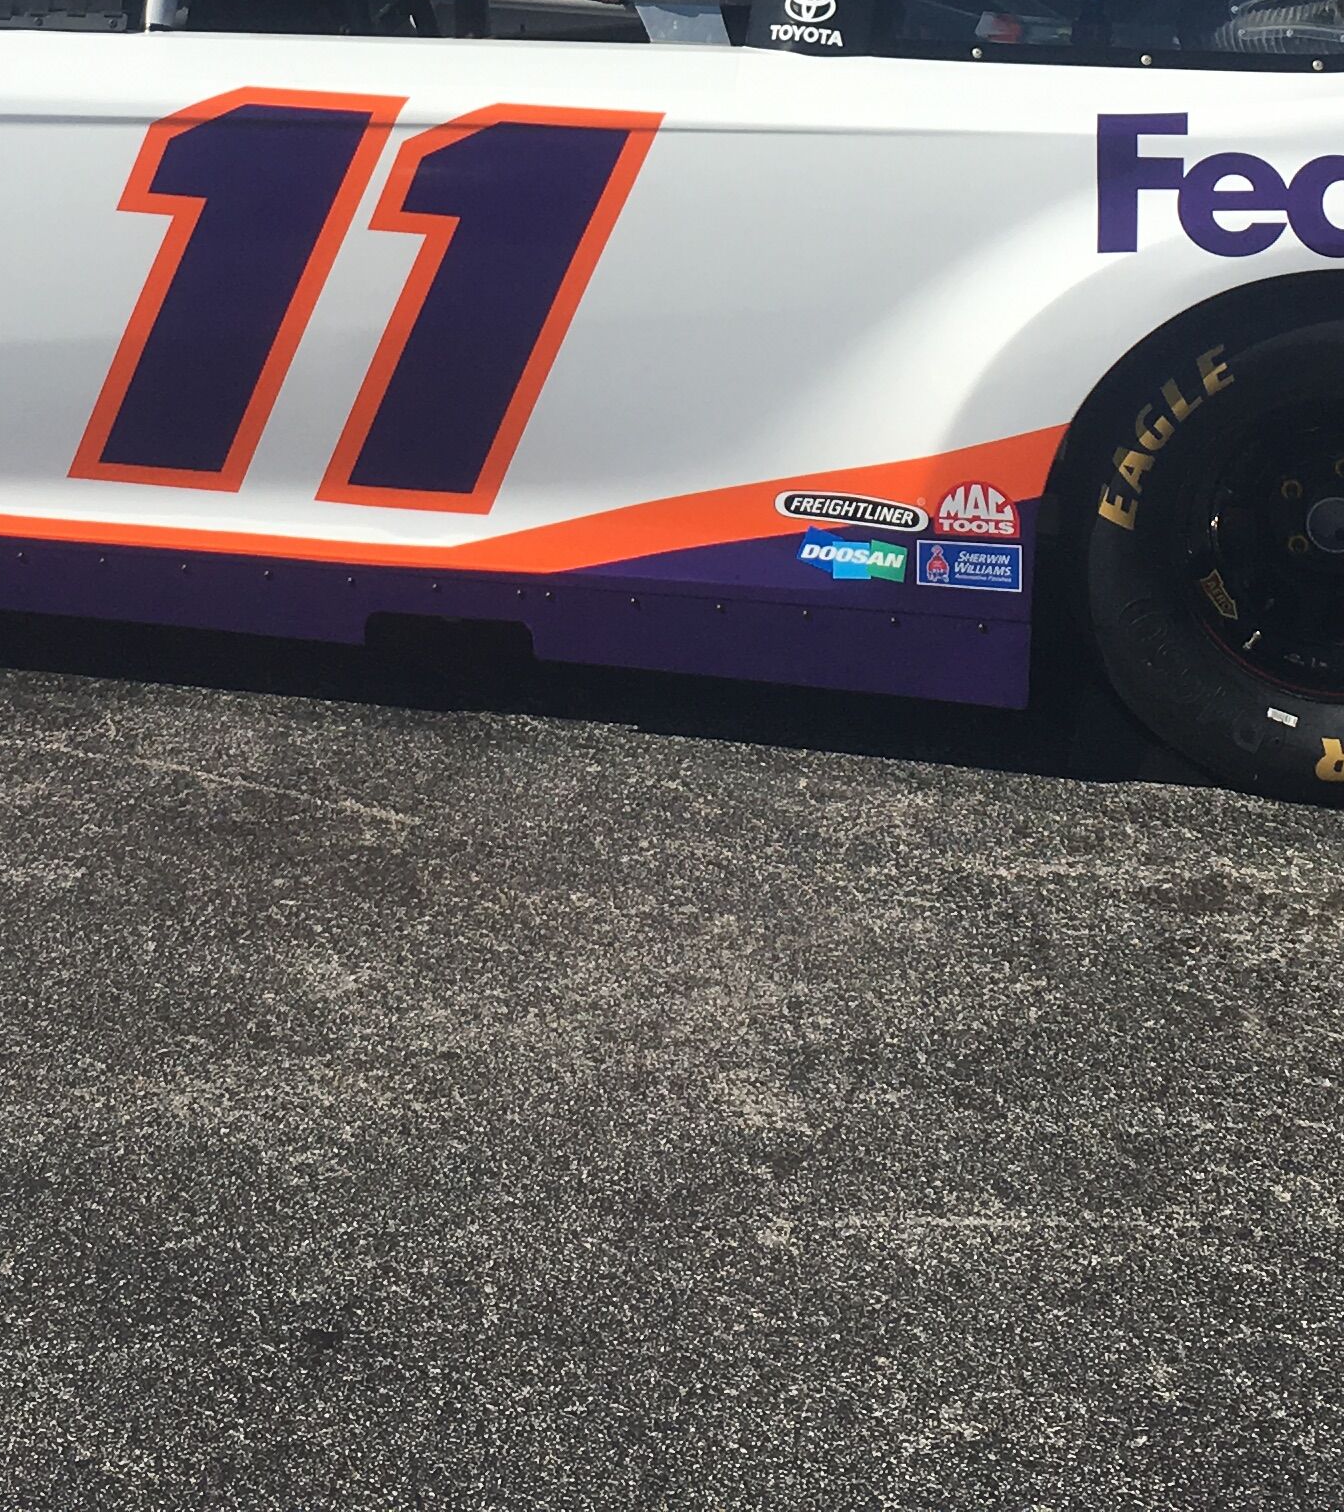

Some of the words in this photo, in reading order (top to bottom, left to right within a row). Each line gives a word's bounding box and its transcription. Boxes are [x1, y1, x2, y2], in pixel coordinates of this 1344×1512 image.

[770, 24, 844, 48] TOYOTA
[67, 85, 667, 516] 11
[1098, 345, 1235, 531] EAGLE
[790, 496, 914, 526] FREIGHTLINER
[939, 484, 1015, 521] MAC
[939, 518, 1015, 535] TOOLS
[800, 543, 905, 570] DOOSAN
[953, 561, 1012, 577] WILLIAMS
[957, 550, 1011, 566] SHERWIN
